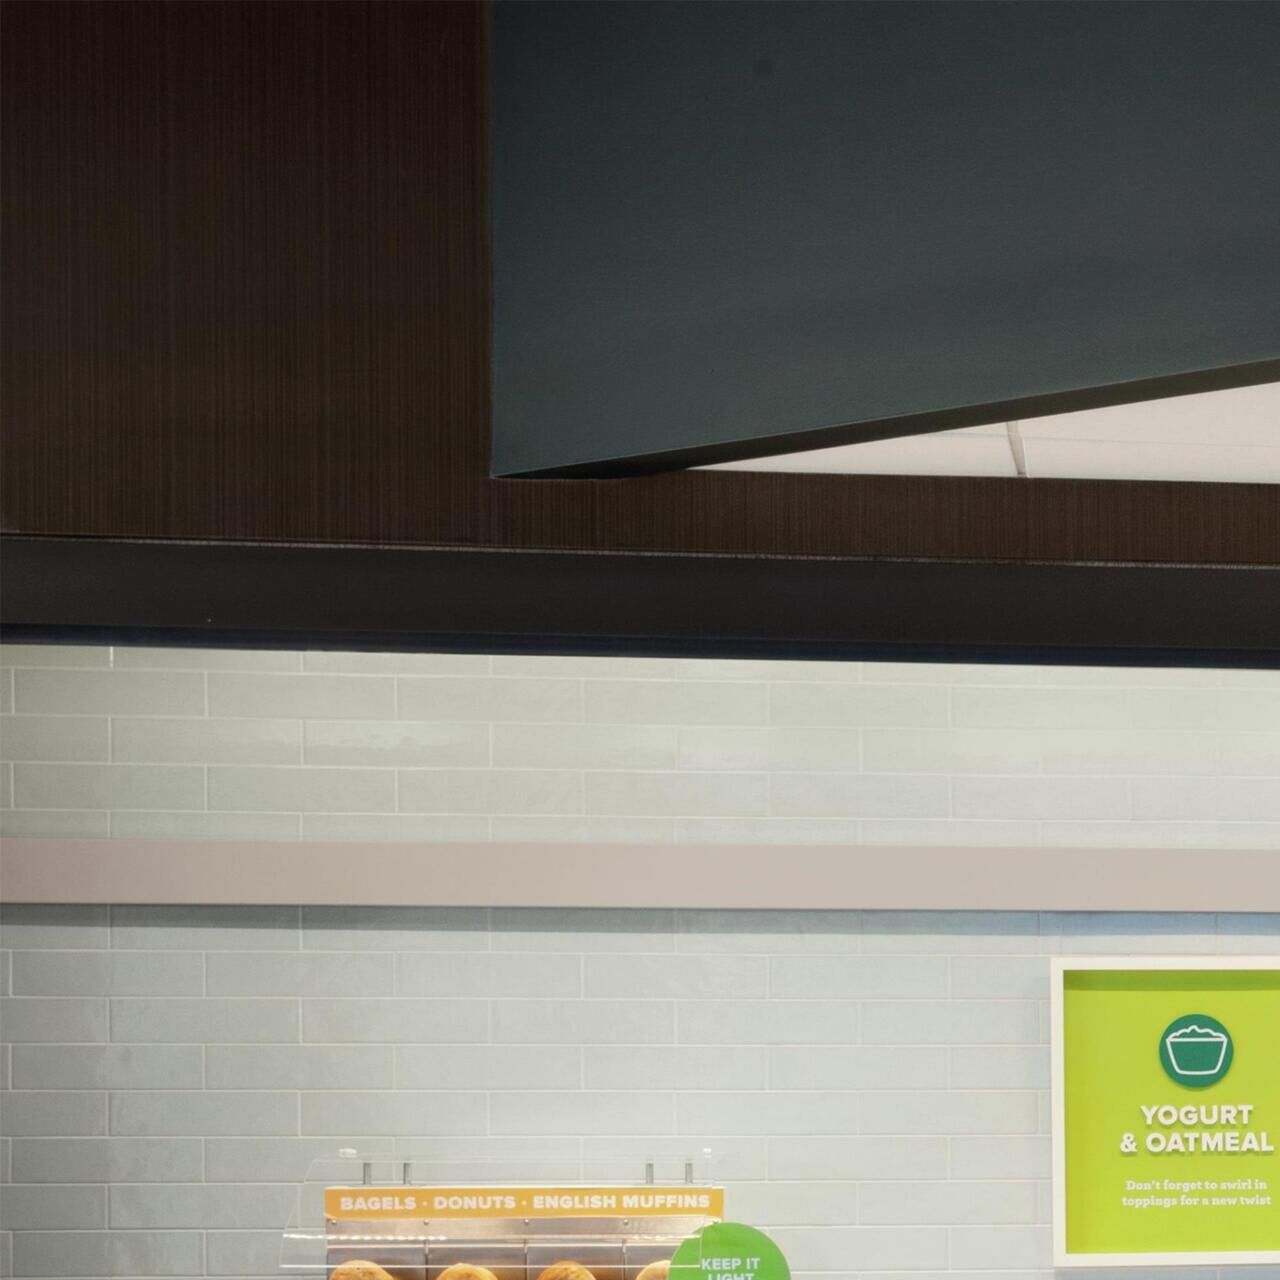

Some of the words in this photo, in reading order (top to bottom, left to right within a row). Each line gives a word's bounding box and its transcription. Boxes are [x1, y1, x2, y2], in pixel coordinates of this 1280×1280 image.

[1140, 1104, 1254, 1126] YOGURT
[1120, 1132, 1138, 1153] &
[1145, 1131, 1275, 1153] OATMEAL
[1126, 1179, 1161, 1191] Don't
[1164, 1179, 1202, 1193] forget
[1204, 1180, 1218, 1190] to
[1220, 1178, 1252, 1190] swirl
[1254, 1178, 1268, 1190] in
[340, 1196, 416, 1211] BAGELS
[434, 1196, 516, 1210] DONUTS
[532, 1194, 617, 1209] ENGLISH
[623, 1192, 710, 1208] MUFFINS
[1122, 1196, 1178, 1208] toppings
[1180, 1195, 1201, 1207] for
[1211, 1198, 1237, 1206] new
[1239, 1195, 1272, 1207] twist
[701, 1257, 741, 1270] KEEP
[746, 1257, 760, 1270] IT
